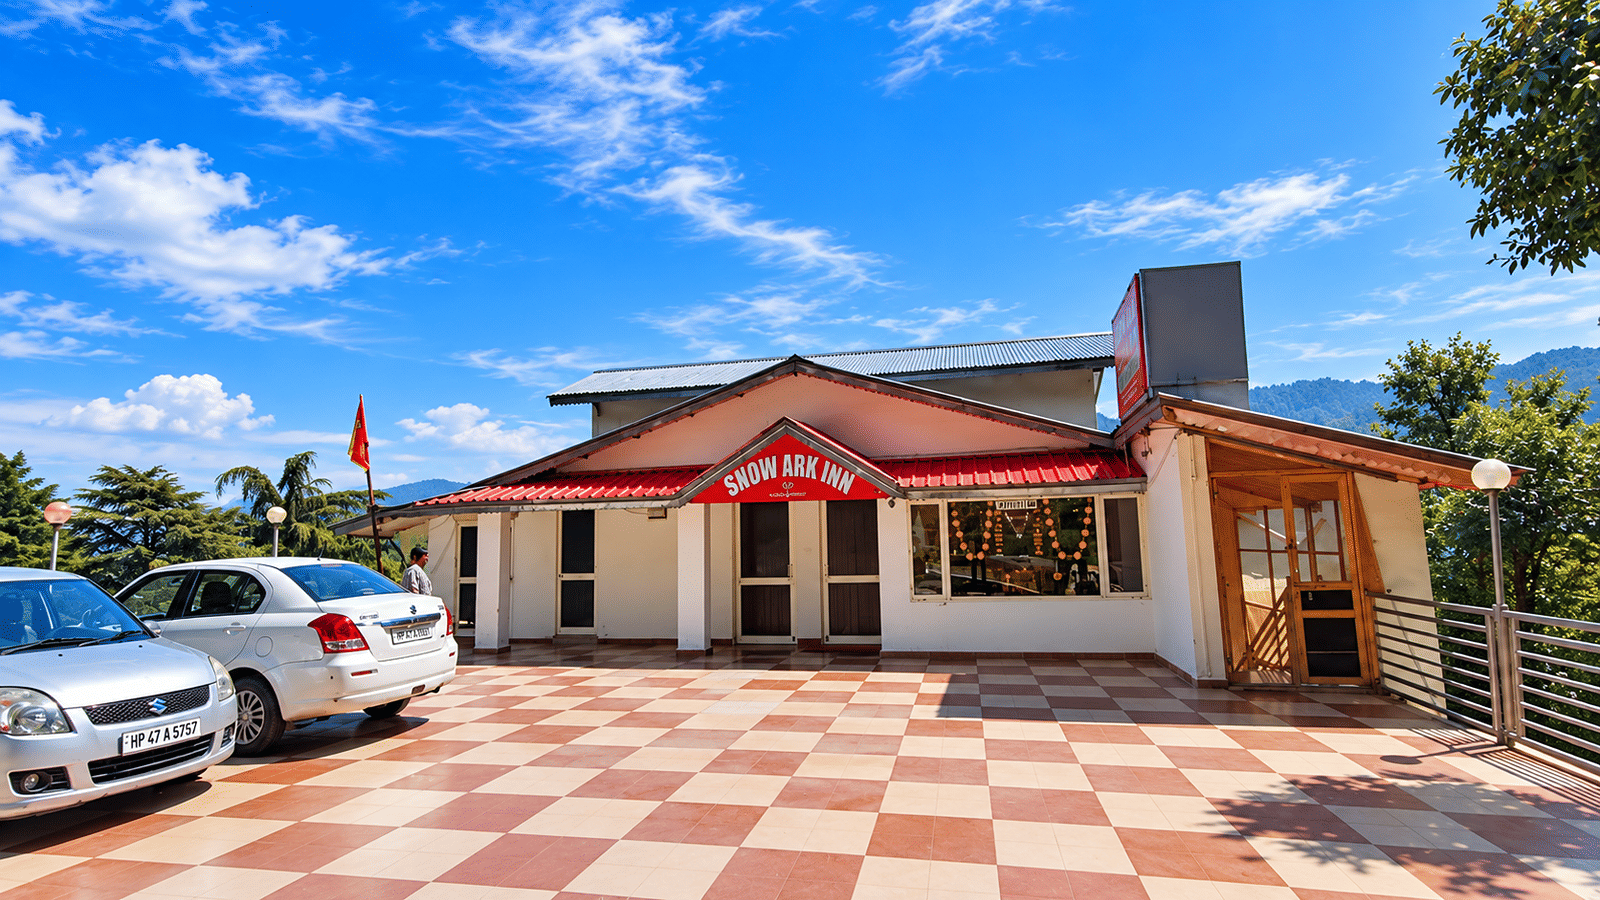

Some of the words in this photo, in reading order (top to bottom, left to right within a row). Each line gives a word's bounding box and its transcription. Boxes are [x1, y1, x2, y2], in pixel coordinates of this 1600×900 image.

[723, 455, 777, 497] SNOW
[782, 454, 819, 480] ARK
[820, 460, 856, 495] INN
[130, 732, 145, 749] HP
[147, 729, 161, 744] 47
[163, 727, 170, 742] A
[172, 721, 198, 739] 5757
